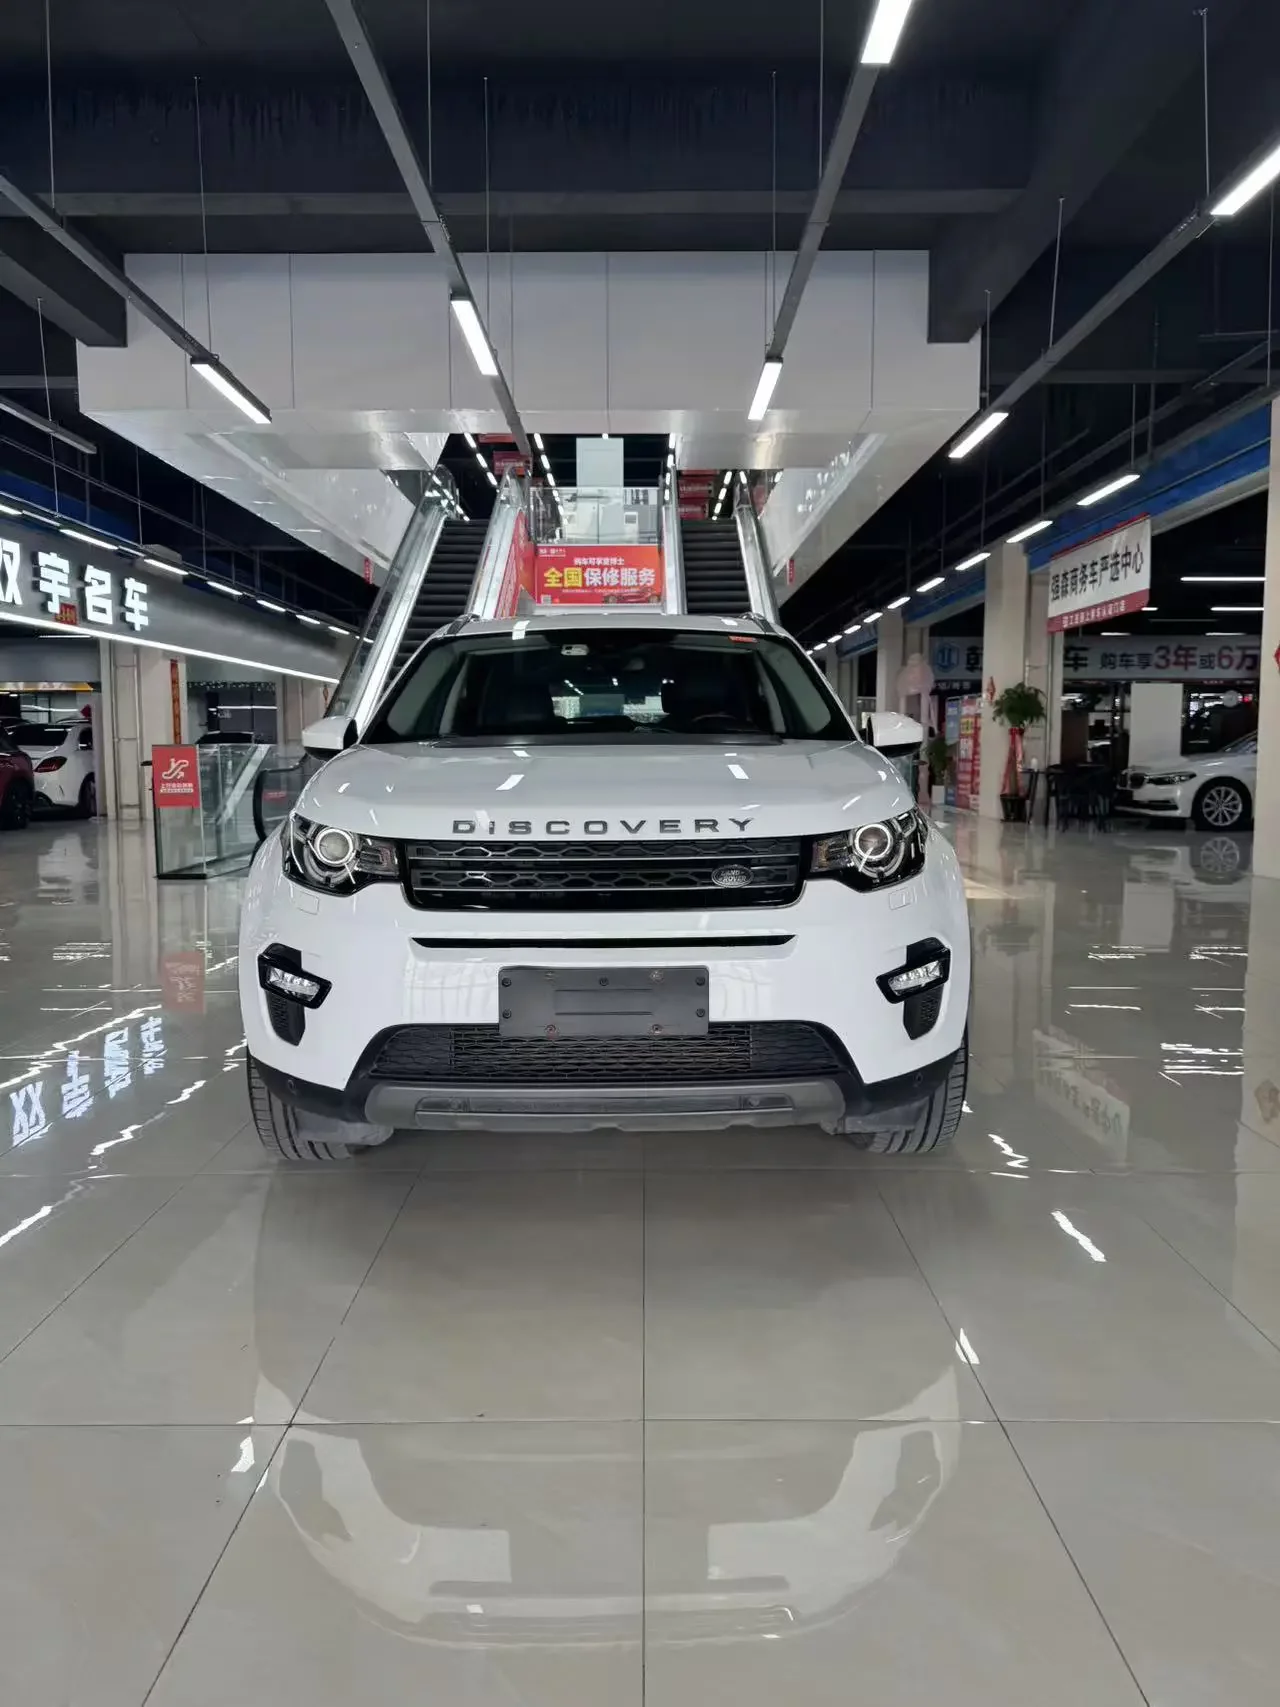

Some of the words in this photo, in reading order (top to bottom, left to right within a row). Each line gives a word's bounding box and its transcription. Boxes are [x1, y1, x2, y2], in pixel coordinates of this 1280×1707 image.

[543, 566, 656, 588] 全国保修服务
[452, 817, 754, 835] DISCOVERY
